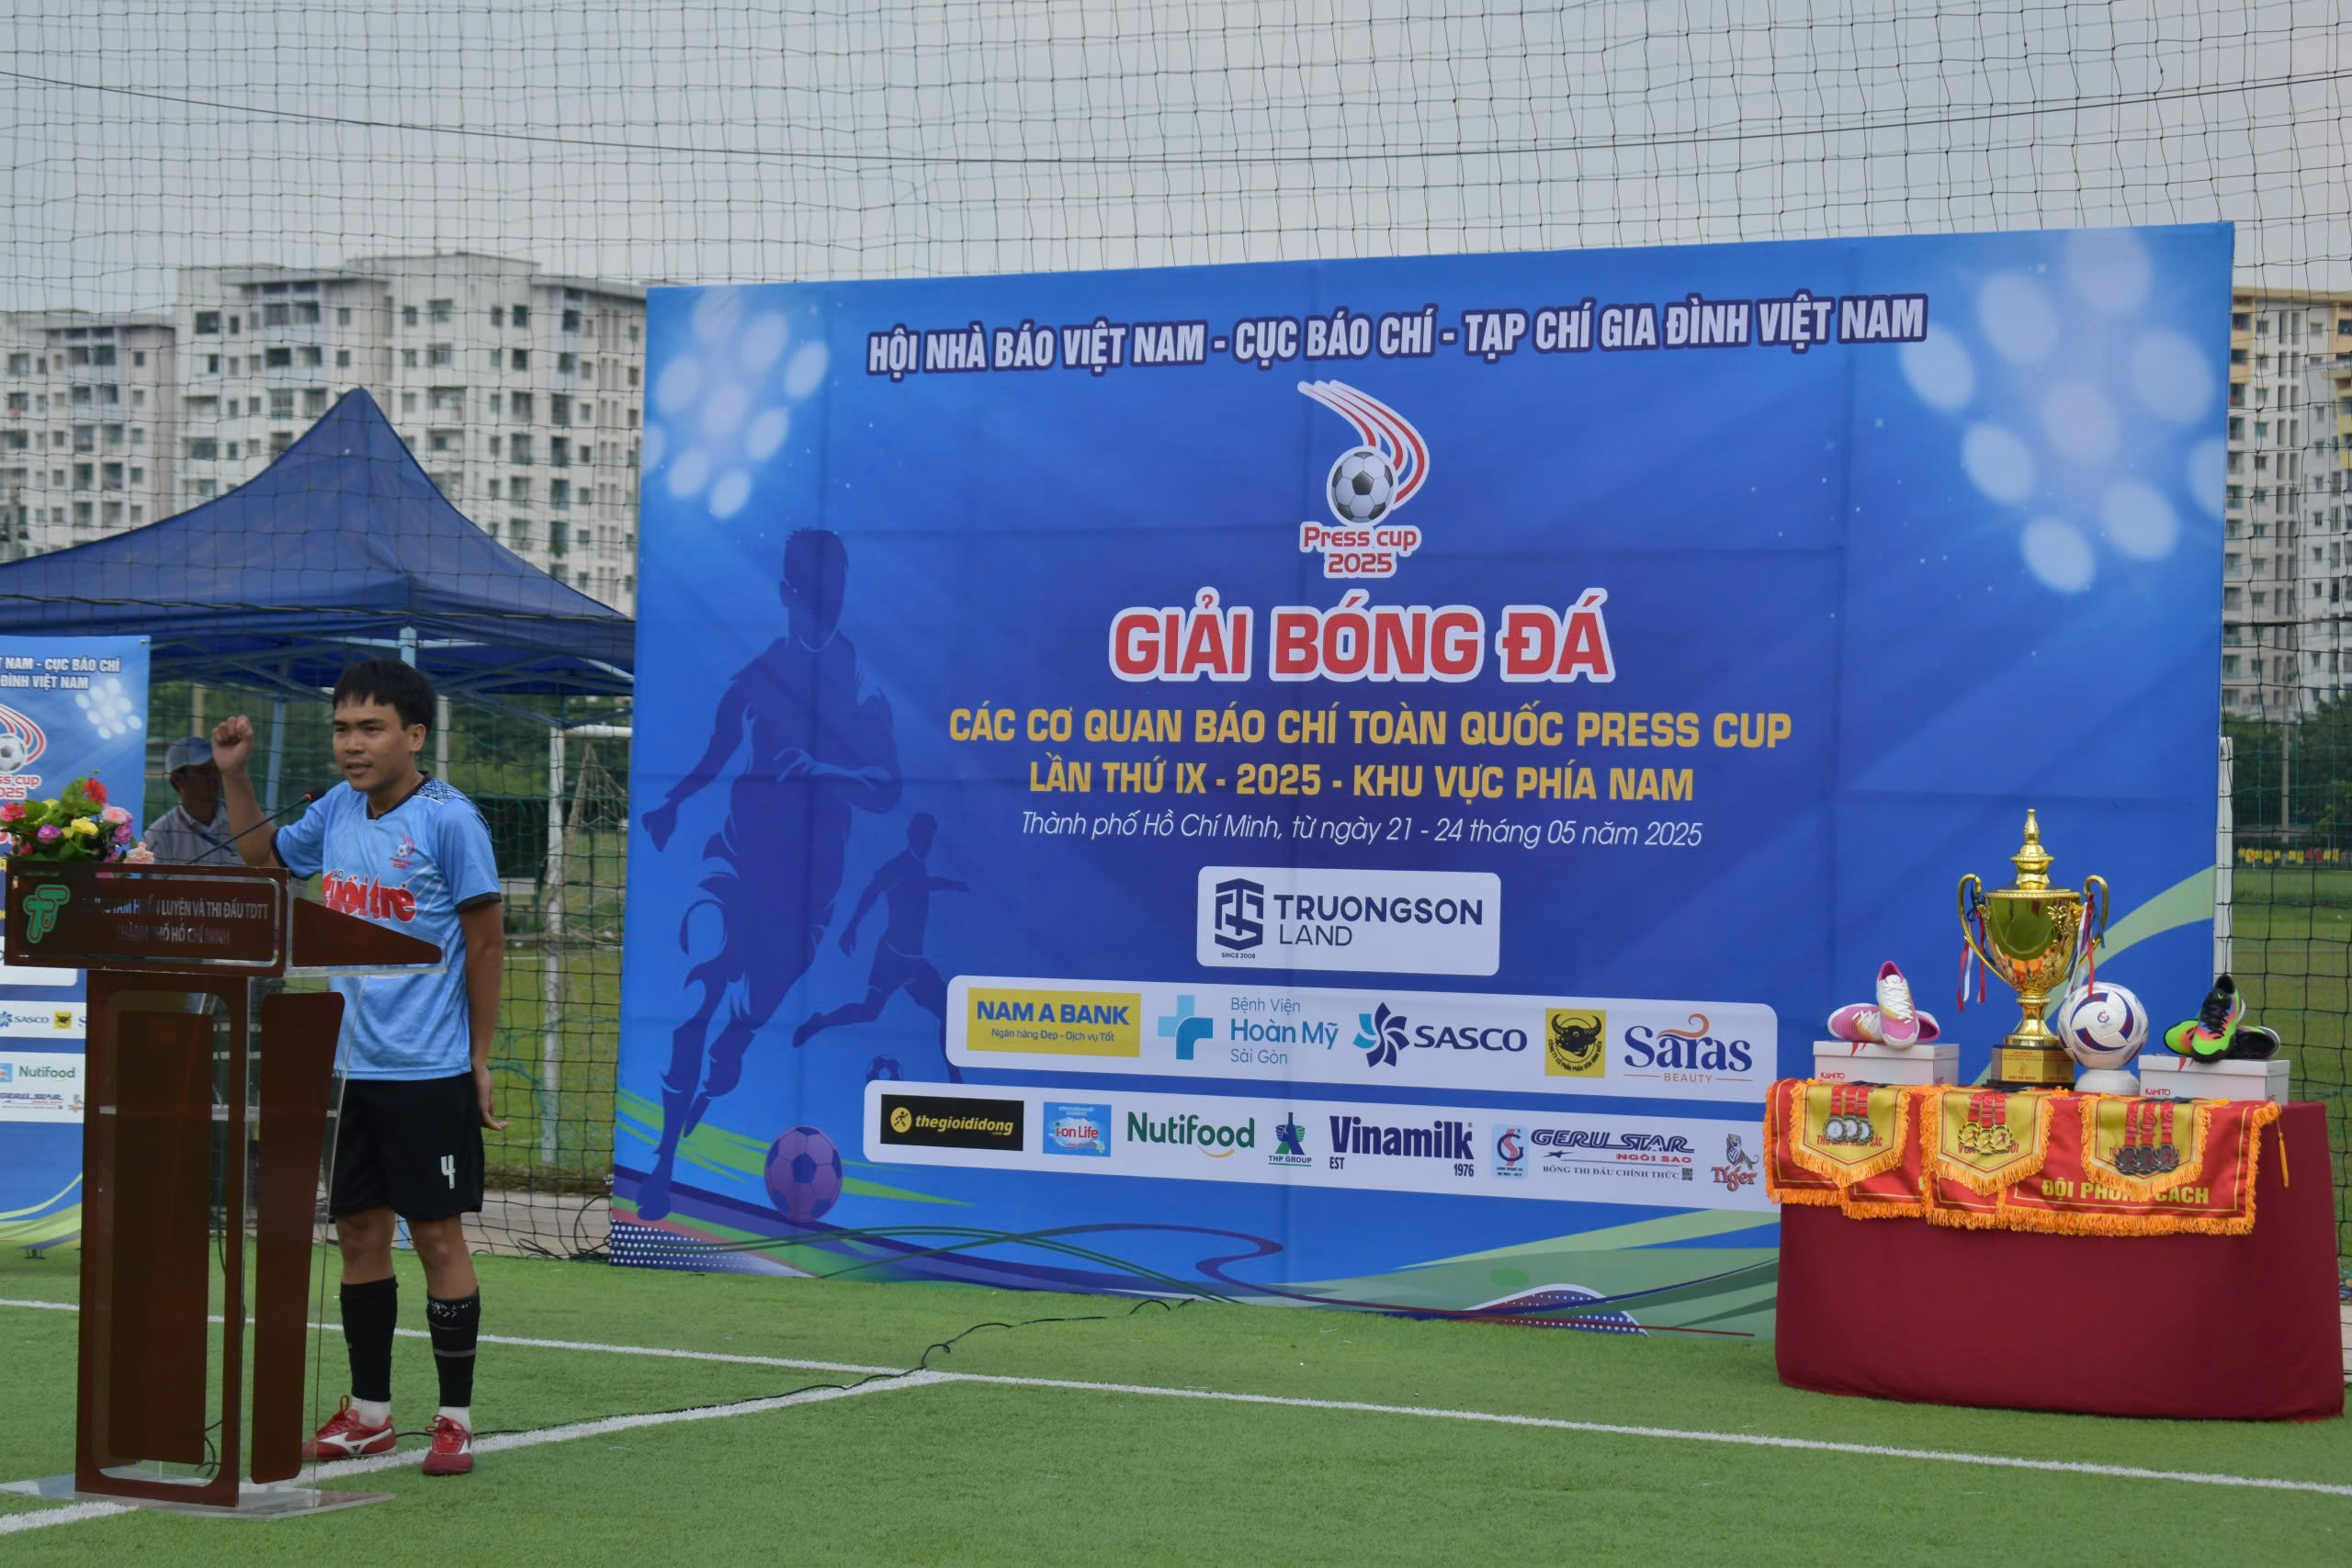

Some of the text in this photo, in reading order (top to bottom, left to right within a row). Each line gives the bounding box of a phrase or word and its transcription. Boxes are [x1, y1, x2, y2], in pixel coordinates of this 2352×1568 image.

[868, 327, 918, 378] HỘI
[925, 324, 987, 369] NHÀ
[994, 322, 1055, 367] BÁO
[1062, 321, 1126, 373] VIỆT
[1133, 324, 1204, 363] NAM
[1235, 321, 1297, 367] CỤC
[1306, 310, 1371, 356] BÁO
[1379, 308, 1435, 355] CHÍ
[1464, 312, 1525, 359] TẠP
[1535, 301, 1593, 350] CHÍ
[1600, 307, 1657, 348] GIA
[1666, 297, 1749, 345] ĐÌNH
[1758, 293, 1832, 349] VIỆT
[1840, 298, 1925, 340] NAM
[1303, 525, 1418, 552] Press cup
[1328, 552, 1393, 574] 2025
[1114, 592, 1610, 676] GIẢI BÓNG ĐÁ
[5, 657, 34, 671] NAM
[44, 658, 70, 673] CỤC
[72, 656, 96, 672] BÁO
[99, 657, 121, 672] CHÍ
[32, 673, 58, 691] VIỆT
[60, 676, 89, 690] NAM
[949, 699, 1792, 749] CÁC CƠ QUAN BÁO CHÍ TOÀN QUỐC PRESS CUP
[15, 776, 40, 788] cup
[1029, 750, 1091, 794] LẦN
[1102, 754, 1167, 794] THỨ
[1175, 762, 1206, 795] IX
[1236, 762, 1322, 796] 2025
[1353, 764, 1423, 797] KHU
[1434, 762, 1504, 805] VỰC
[1516, 759, 1598, 800] PHÍA
[1609, 767, 1695, 802] NAM
[1022, 810, 1087, 836] Thành
[1091, 808, 1141, 840] phố
[1143, 807, 1175, 836] Hồ
[1181, 812, 1224, 838] Chí
[1224, 814, 1283, 840] Minh,
[1292, 814, 1317, 839] từ
[1319, 814, 1382, 845] ngày
[1385, 817, 1413, 841] 21
[1433, 818, 1464, 842] 24
[1469, 818, 1542, 850] tháng
[1546, 819, 1577, 844] 05
[1581, 821, 1639, 846] năm
[1644, 821, 1703, 846] 2025
[162, 897, 192, 920] LUYỆN
[193, 898, 206, 917] VÀ
[207, 901, 221, 918] THI
[223, 897, 243, 919] ĐẤU
[245, 903, 269, 919] TDTT
[1272, 893, 1484, 926] TRUONGSON
[150, 922, 170, 942] HỐ
[1278, 923, 1354, 947] LAND
[977, 1000, 1130, 1026] NAM A BANK
[1230, 997, 1301, 1015] Bệnh Viện
[14, 1015, 50, 1024] SASCO
[991, 1028, 1015, 1041] Ngân
[1016, 1029, 1039, 1043] hàng
[1040, 1030, 1058, 1044] Đẹp
[1066, 1031, 1085, 1043] Dịch
[1087, 1033, 1098, 1044] vụ
[1099, 1031, 1115, 1043] Tốt
[1230, 1018, 1339, 1051] Hoàn Mỹ
[1412, 1025, 1528, 1053] SASCO
[1230, 1048, 1288, 1066] Sài Gòn
[1623, 1022, 1753, 1073] Saras
[18, 1066, 76, 1079] Nutifood
[1664, 1073, 1713, 1084] BEAUTY
[2144, 1088, 2171, 1096] KAMITO
[915, 1114, 1014, 1135] thegioididong
[1078, 1125, 1099, 1139] Life
[1127, 1111, 1256, 1149] Nutifood
[1329, 1115, 1475, 1160] Vinamilk
[1620, 1133, 1695, 1154] STAR
[1268, 1155, 1312, 1164] THP GROUP
[1329, 1156, 1475, 1177] EST 1976
[1616, 1153, 1692, 1164] NGÔI SAO
[440, 1154, 456, 1190] 4
[1543, 1164, 1679, 1179] BÓNG THI ĐẤU CHÍNH THỨC
[1711, 1165, 1758, 1192] Tiger
[2041, 1177, 2074, 1201] ĐỘI
[2080, 1181, 2143, 1202] PHO
